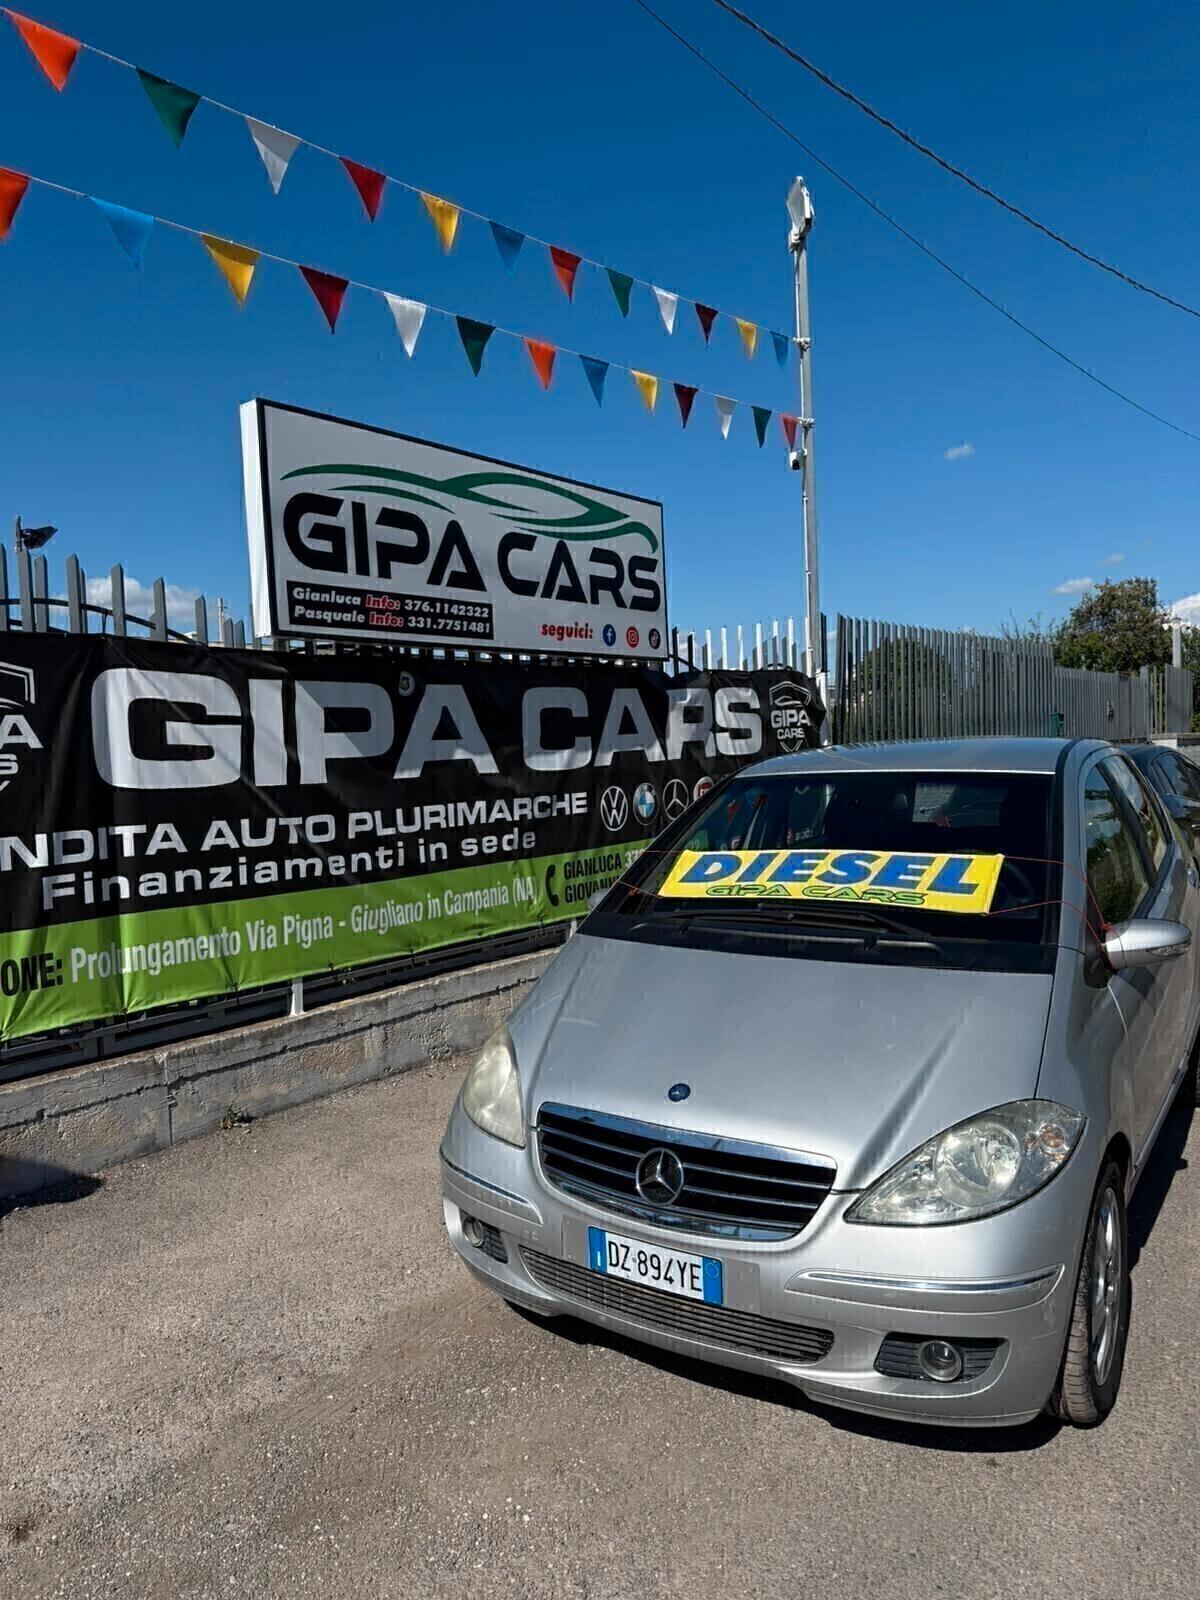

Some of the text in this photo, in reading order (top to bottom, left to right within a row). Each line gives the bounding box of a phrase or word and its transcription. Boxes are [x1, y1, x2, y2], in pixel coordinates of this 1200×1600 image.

[283, 492, 660, 613] GIPA CARS
[293, 587, 489, 618] Gianluca Info: 376.1142322
[294, 605, 491, 633] Pasquale Info: 331.7751481
[541, 621, 593, 641] seguici:
[91, 667, 762, 790] GIPA CARS
[770, 709, 811, 728] GIPA
[777, 727, 805, 740] CARS
[0, 791, 588, 872] NDITA AUTO PLURIMARCHE
[42, 828, 536, 910] Finanziamenti in sede
[563, 853, 622, 880] GIANLUCA
[678, 852, 978, 895] DIESEL
[705, 884, 928, 906] GIPA CARS
[0, 952, 63, 996] ONE:
[71, 926, 241, 983] Prolungamento
[246, 919, 277, 952] Via
[283, 913, 333, 949] Pigna
[351, 899, 423, 935] Giugliano
[428, 892, 441, 918] in
[444, 881, 509, 916] Campania
[512, 875, 537, 908] (NA)
[608, 1240, 631, 1272] DZ
[637, 1250, 703, 1292] 894YE
